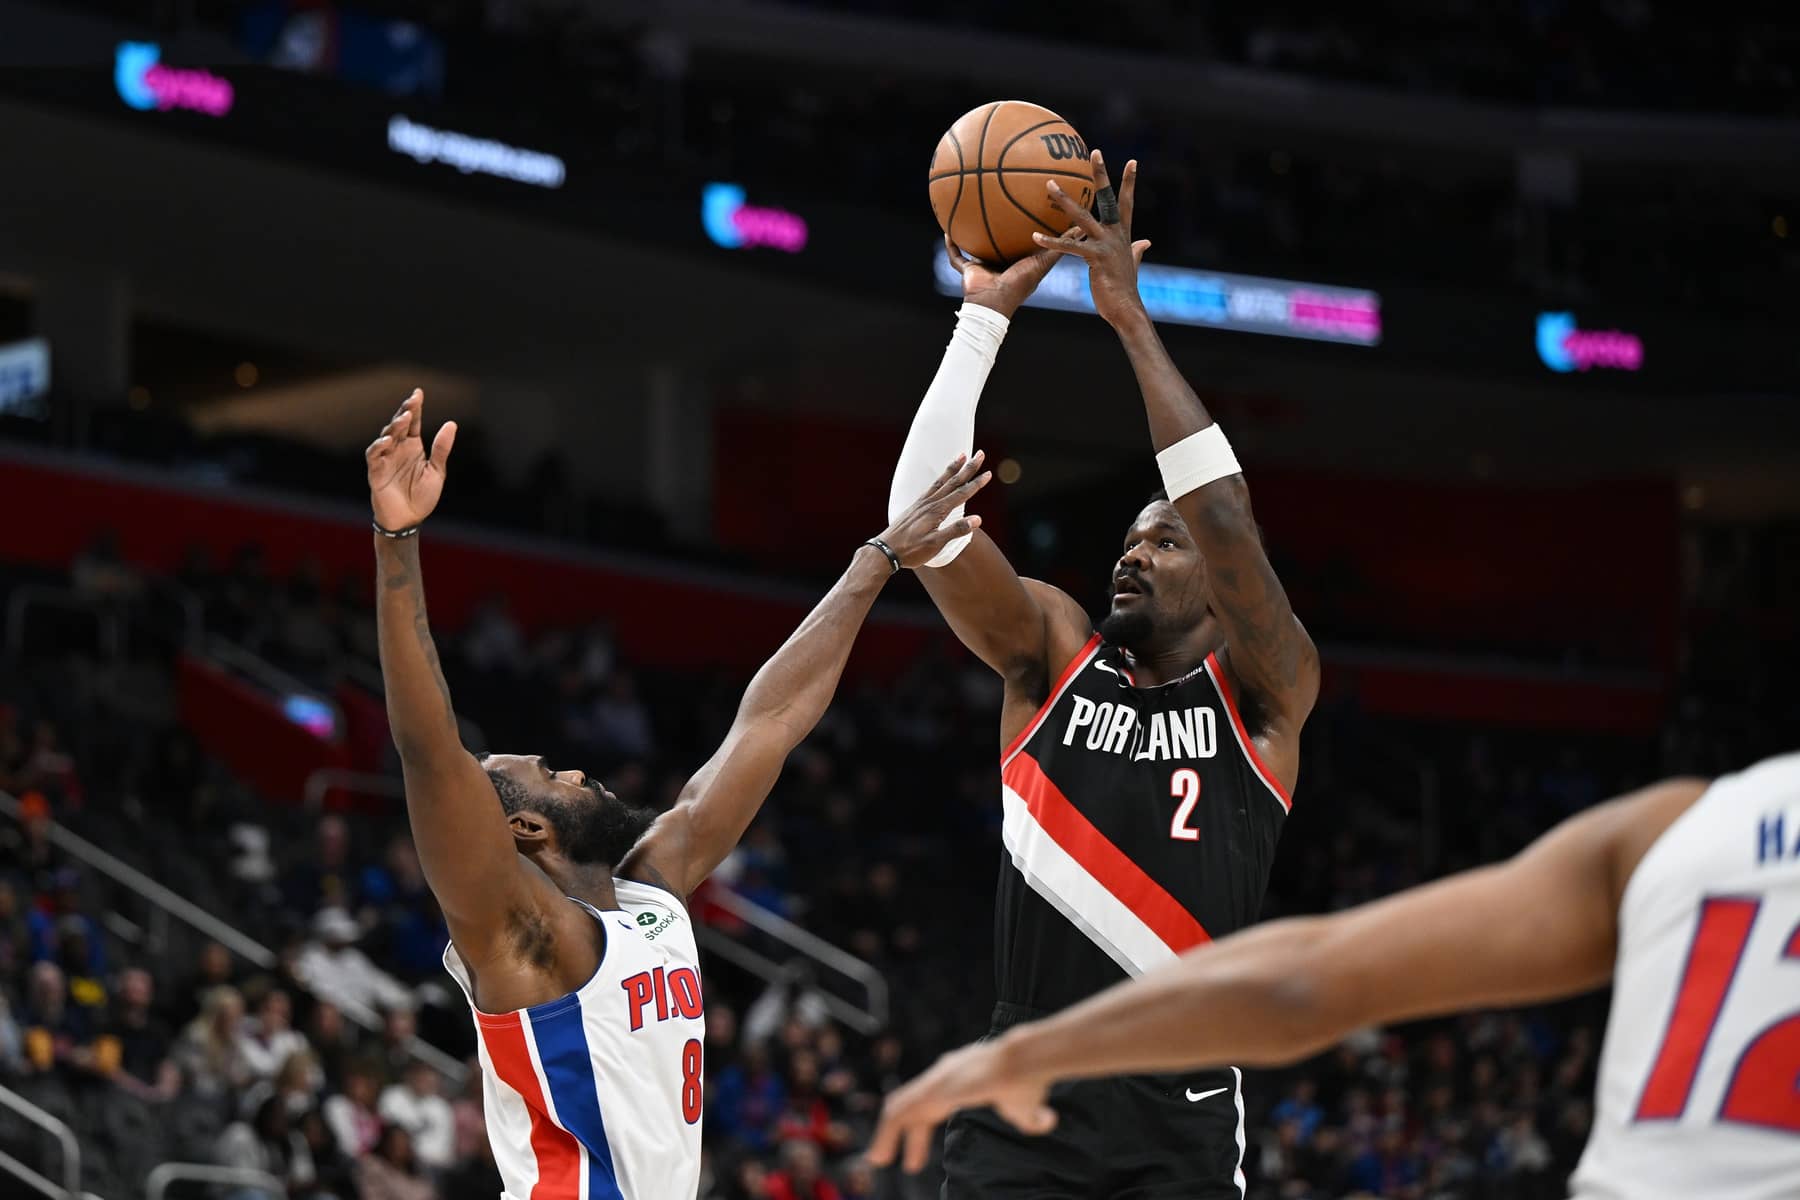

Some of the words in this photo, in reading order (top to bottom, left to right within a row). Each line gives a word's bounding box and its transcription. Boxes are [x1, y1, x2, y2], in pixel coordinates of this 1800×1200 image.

[1062, 694, 1217, 762] PORLAND
[1170, 768, 1200, 841] 2
[1758, 812, 1800, 864] H
[682, 1038, 702, 1125] 8
